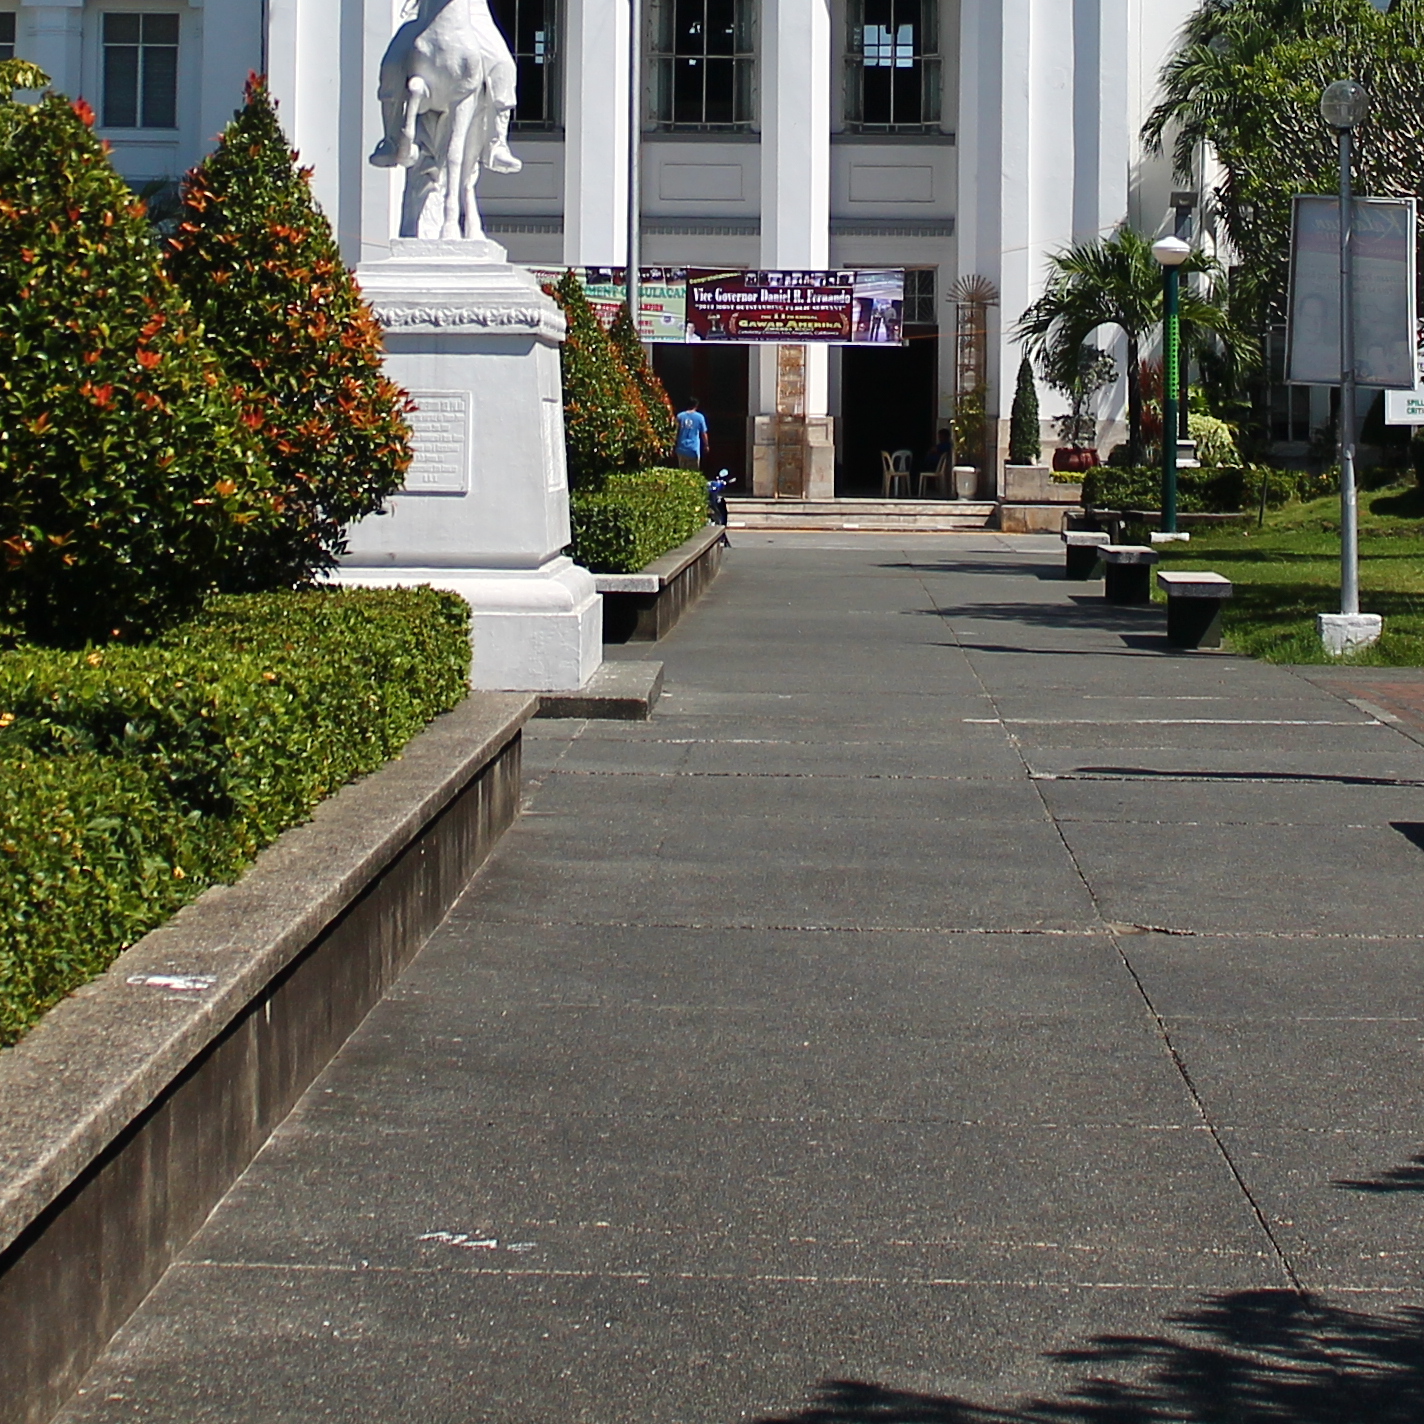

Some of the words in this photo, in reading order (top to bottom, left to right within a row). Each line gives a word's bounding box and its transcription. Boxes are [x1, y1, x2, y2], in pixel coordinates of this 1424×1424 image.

[693, 287, 713, 302] Vice
[715, 287, 758, 303] Governor
[760, 288, 791, 304] Daniel
[806, 289, 851, 305] Fernando
